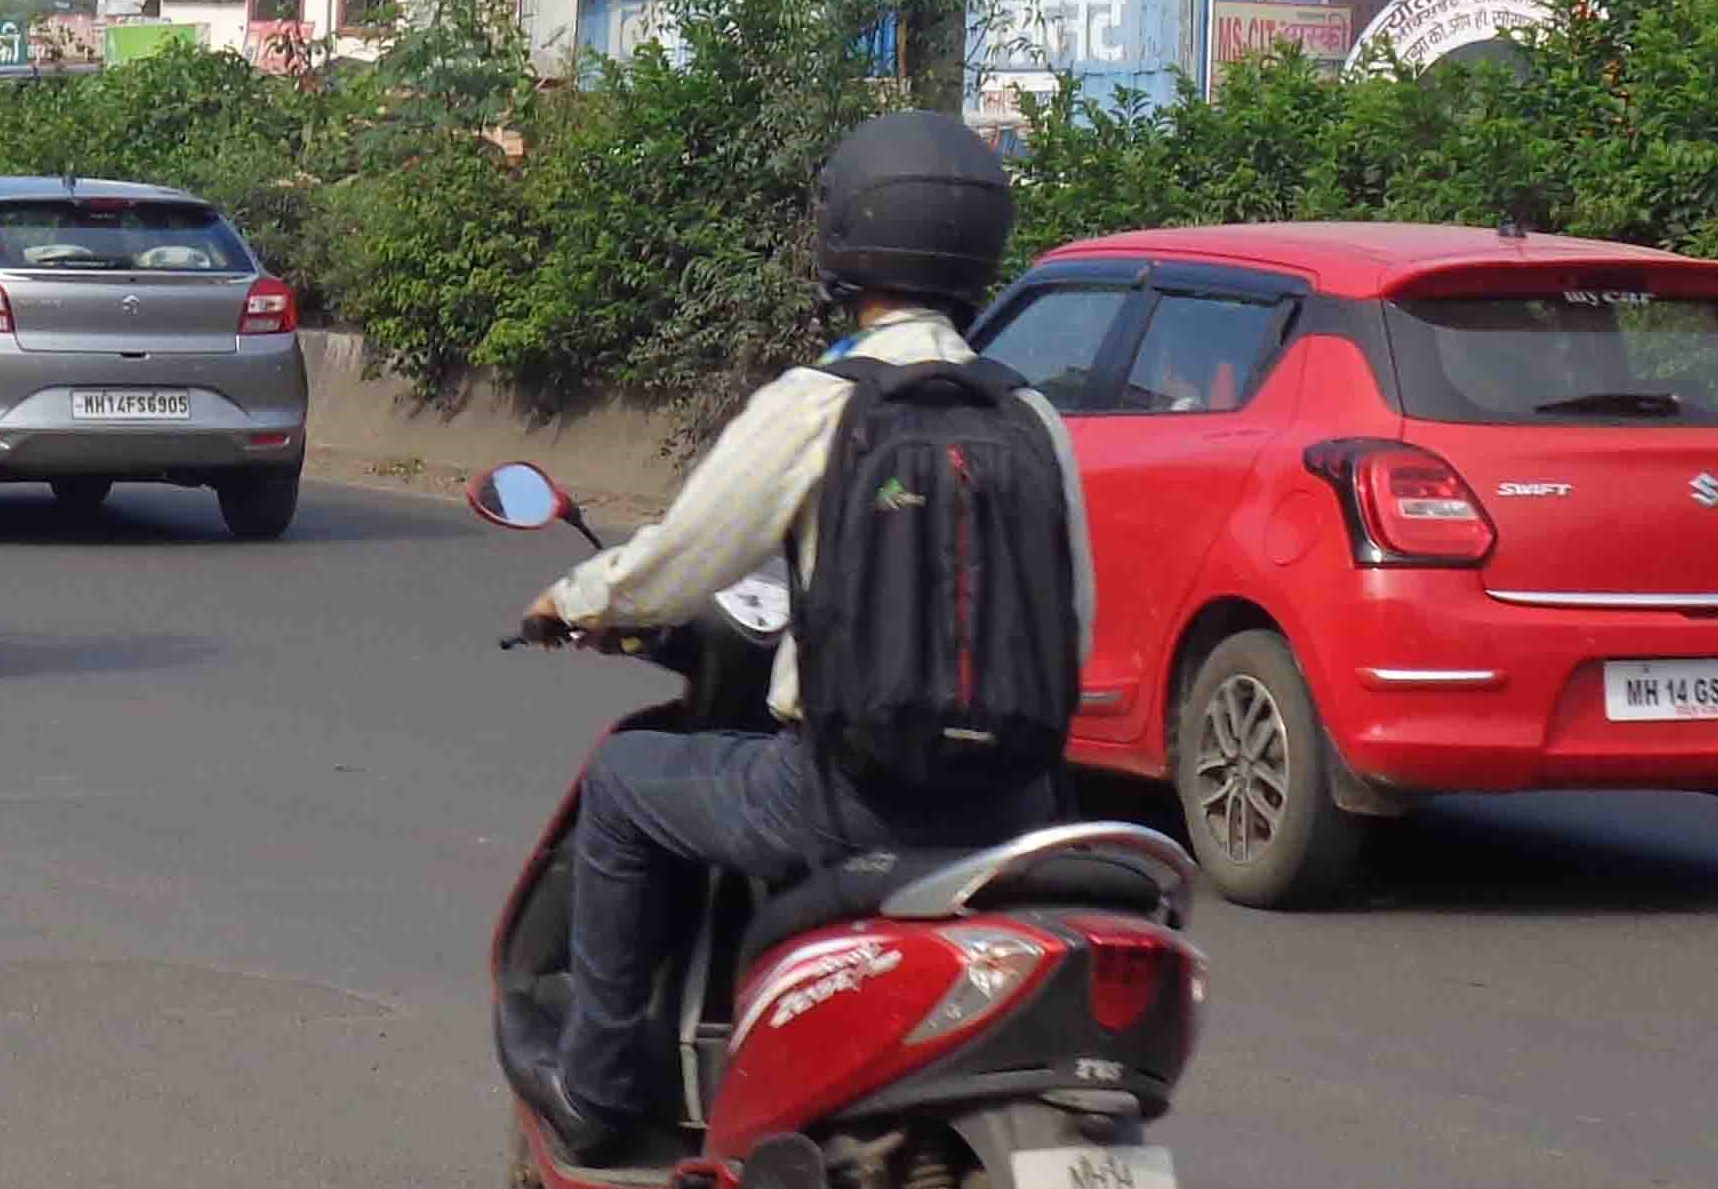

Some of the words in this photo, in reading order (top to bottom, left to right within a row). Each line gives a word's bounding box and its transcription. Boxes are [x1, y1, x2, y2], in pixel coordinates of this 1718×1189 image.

[84, 395, 188, 413] MH14FS6905
[1498, 482, 1572, 496] SWIFT
[1627, 678, 1659, 706] MH
[1667, 678, 1688, 705] 14
